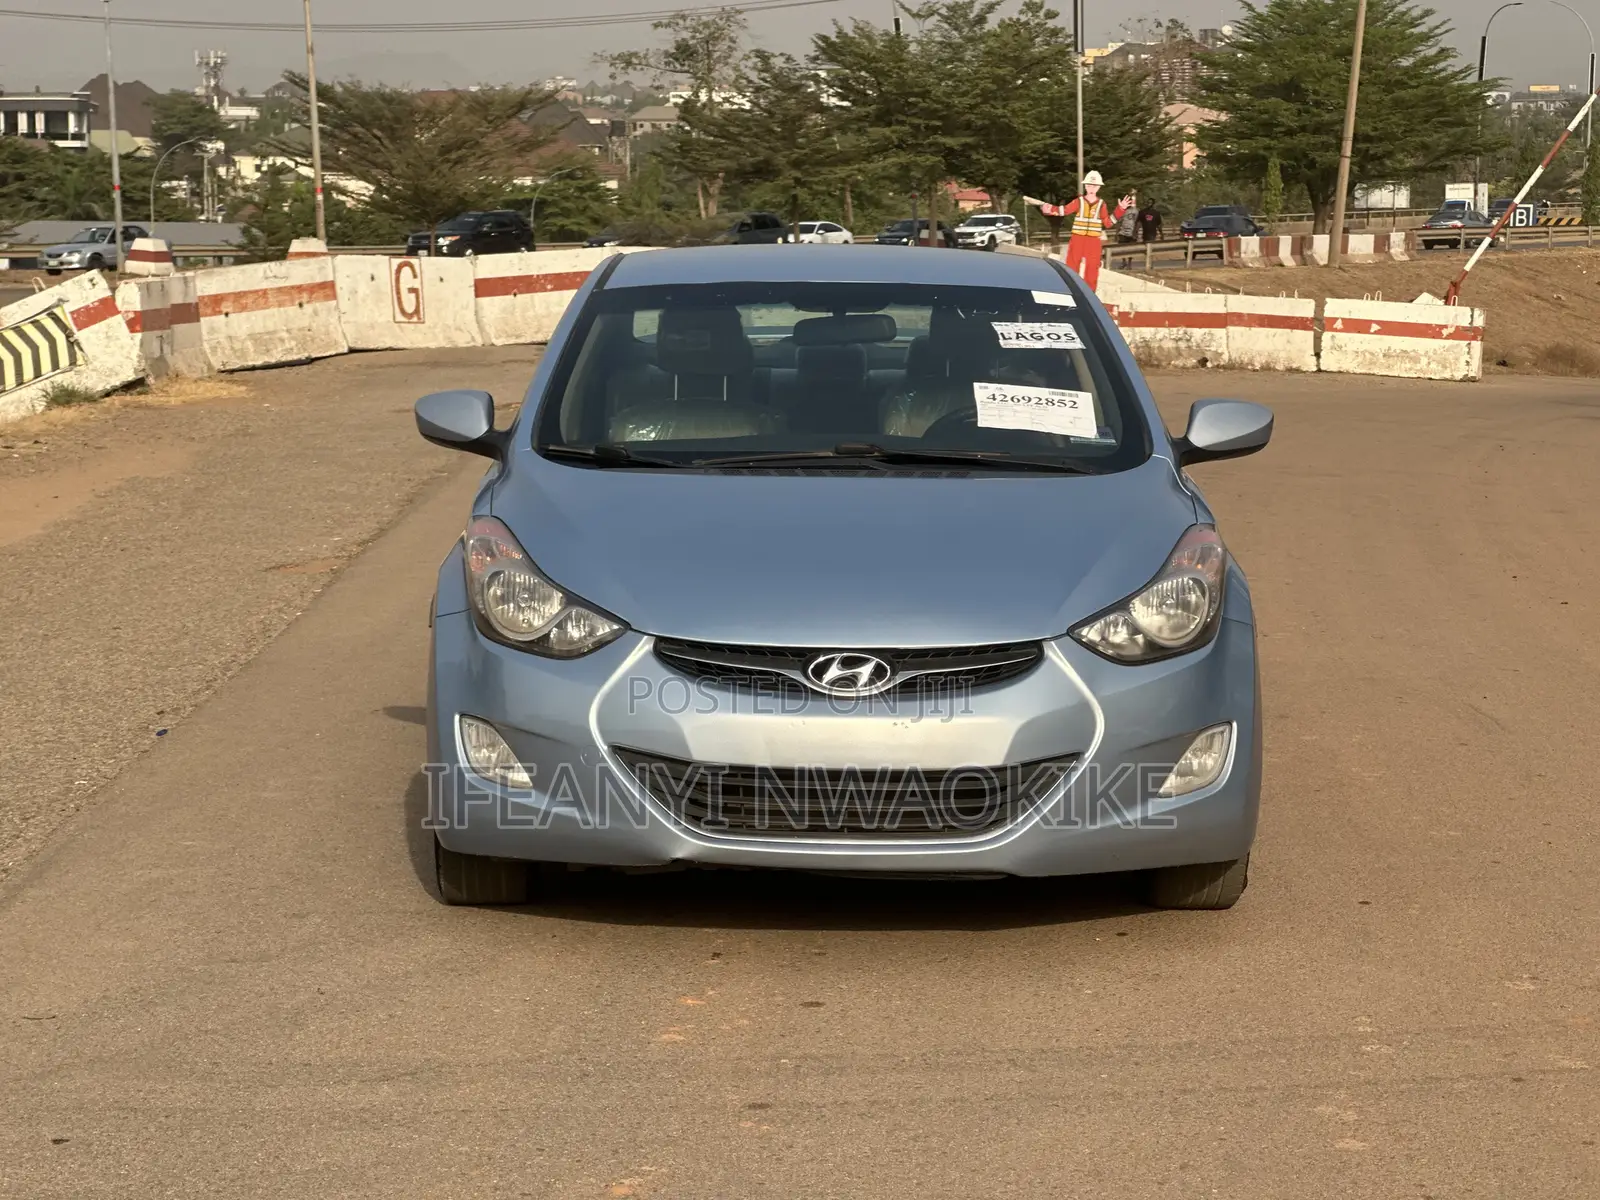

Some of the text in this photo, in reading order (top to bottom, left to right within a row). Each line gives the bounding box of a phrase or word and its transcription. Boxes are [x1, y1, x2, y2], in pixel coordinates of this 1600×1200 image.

[394, 260, 421, 320] G
[1000, 332, 1076, 341] LAGOS
[986, 393, 1079, 409] 42692852
